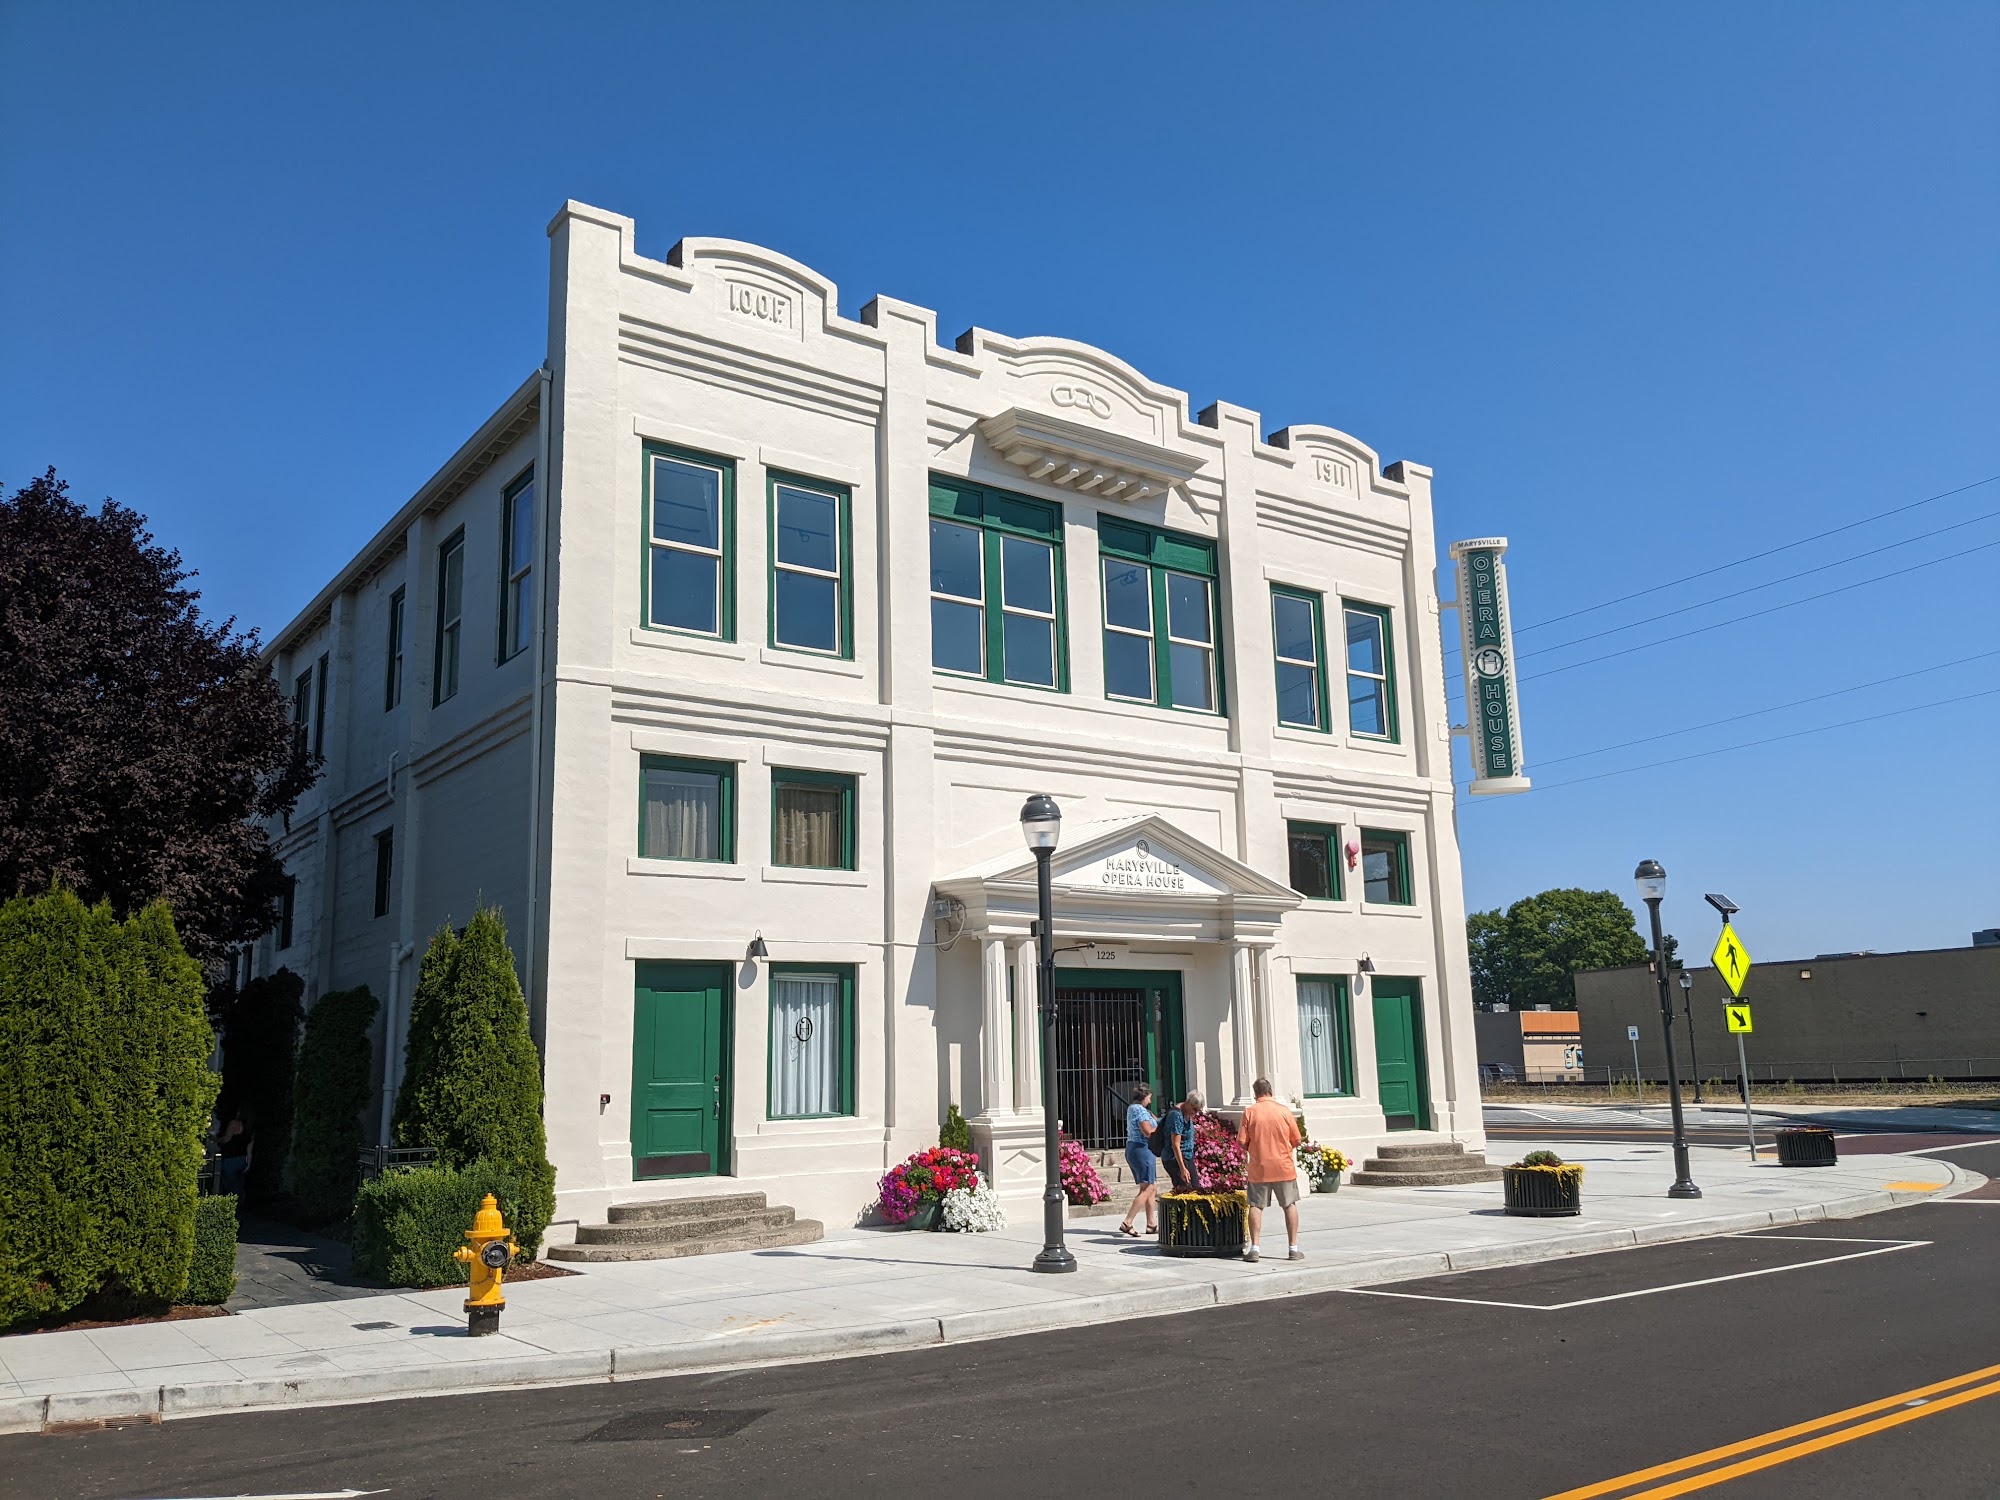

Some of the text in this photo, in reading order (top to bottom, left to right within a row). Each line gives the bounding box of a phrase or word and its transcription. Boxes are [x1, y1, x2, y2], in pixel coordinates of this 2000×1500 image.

[1316, 459, 1345, 487] 1911
[1457, 539, 1501, 548] MARYSVILLE
[1473, 556, 1496, 639] OPERA
[1485, 684, 1507, 769] HOUSE
[1106, 859, 1180, 875] MARYSVILLE
[1102, 873, 1184, 889] OPERA HOUSE
[1096, 951, 1116, 960] 1225
